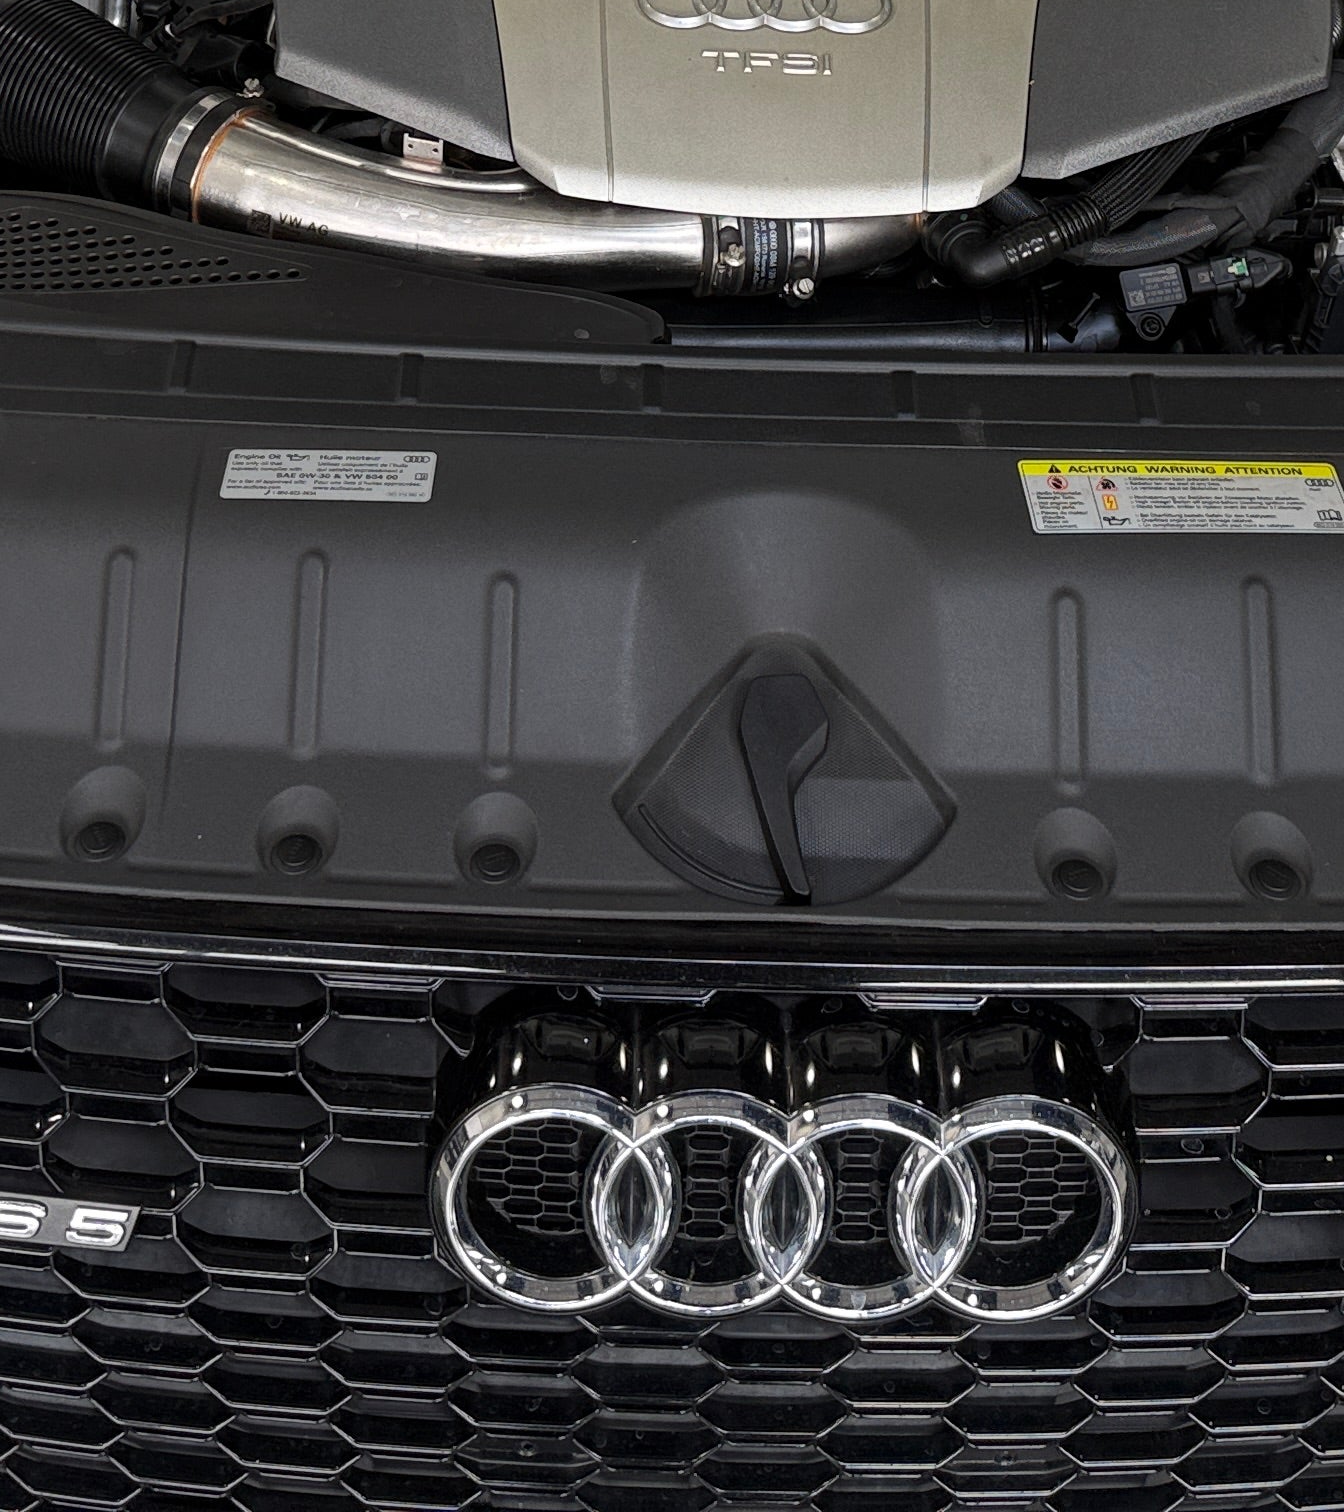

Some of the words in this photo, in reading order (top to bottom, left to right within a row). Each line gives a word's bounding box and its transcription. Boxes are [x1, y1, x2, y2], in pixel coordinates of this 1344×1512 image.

[701, 49, 833, 76] TFSI
[279, 211, 303, 229] VW
[306, 221, 330, 237] AG
[234, 453, 266, 461] Engine
[1068, 465, 1138, 474] ACHTUNG
[1145, 466, 1217, 475] WARNING
[1224, 466, 1304, 476] ATTENTION
[64, 1205, 131, 1247] 5
